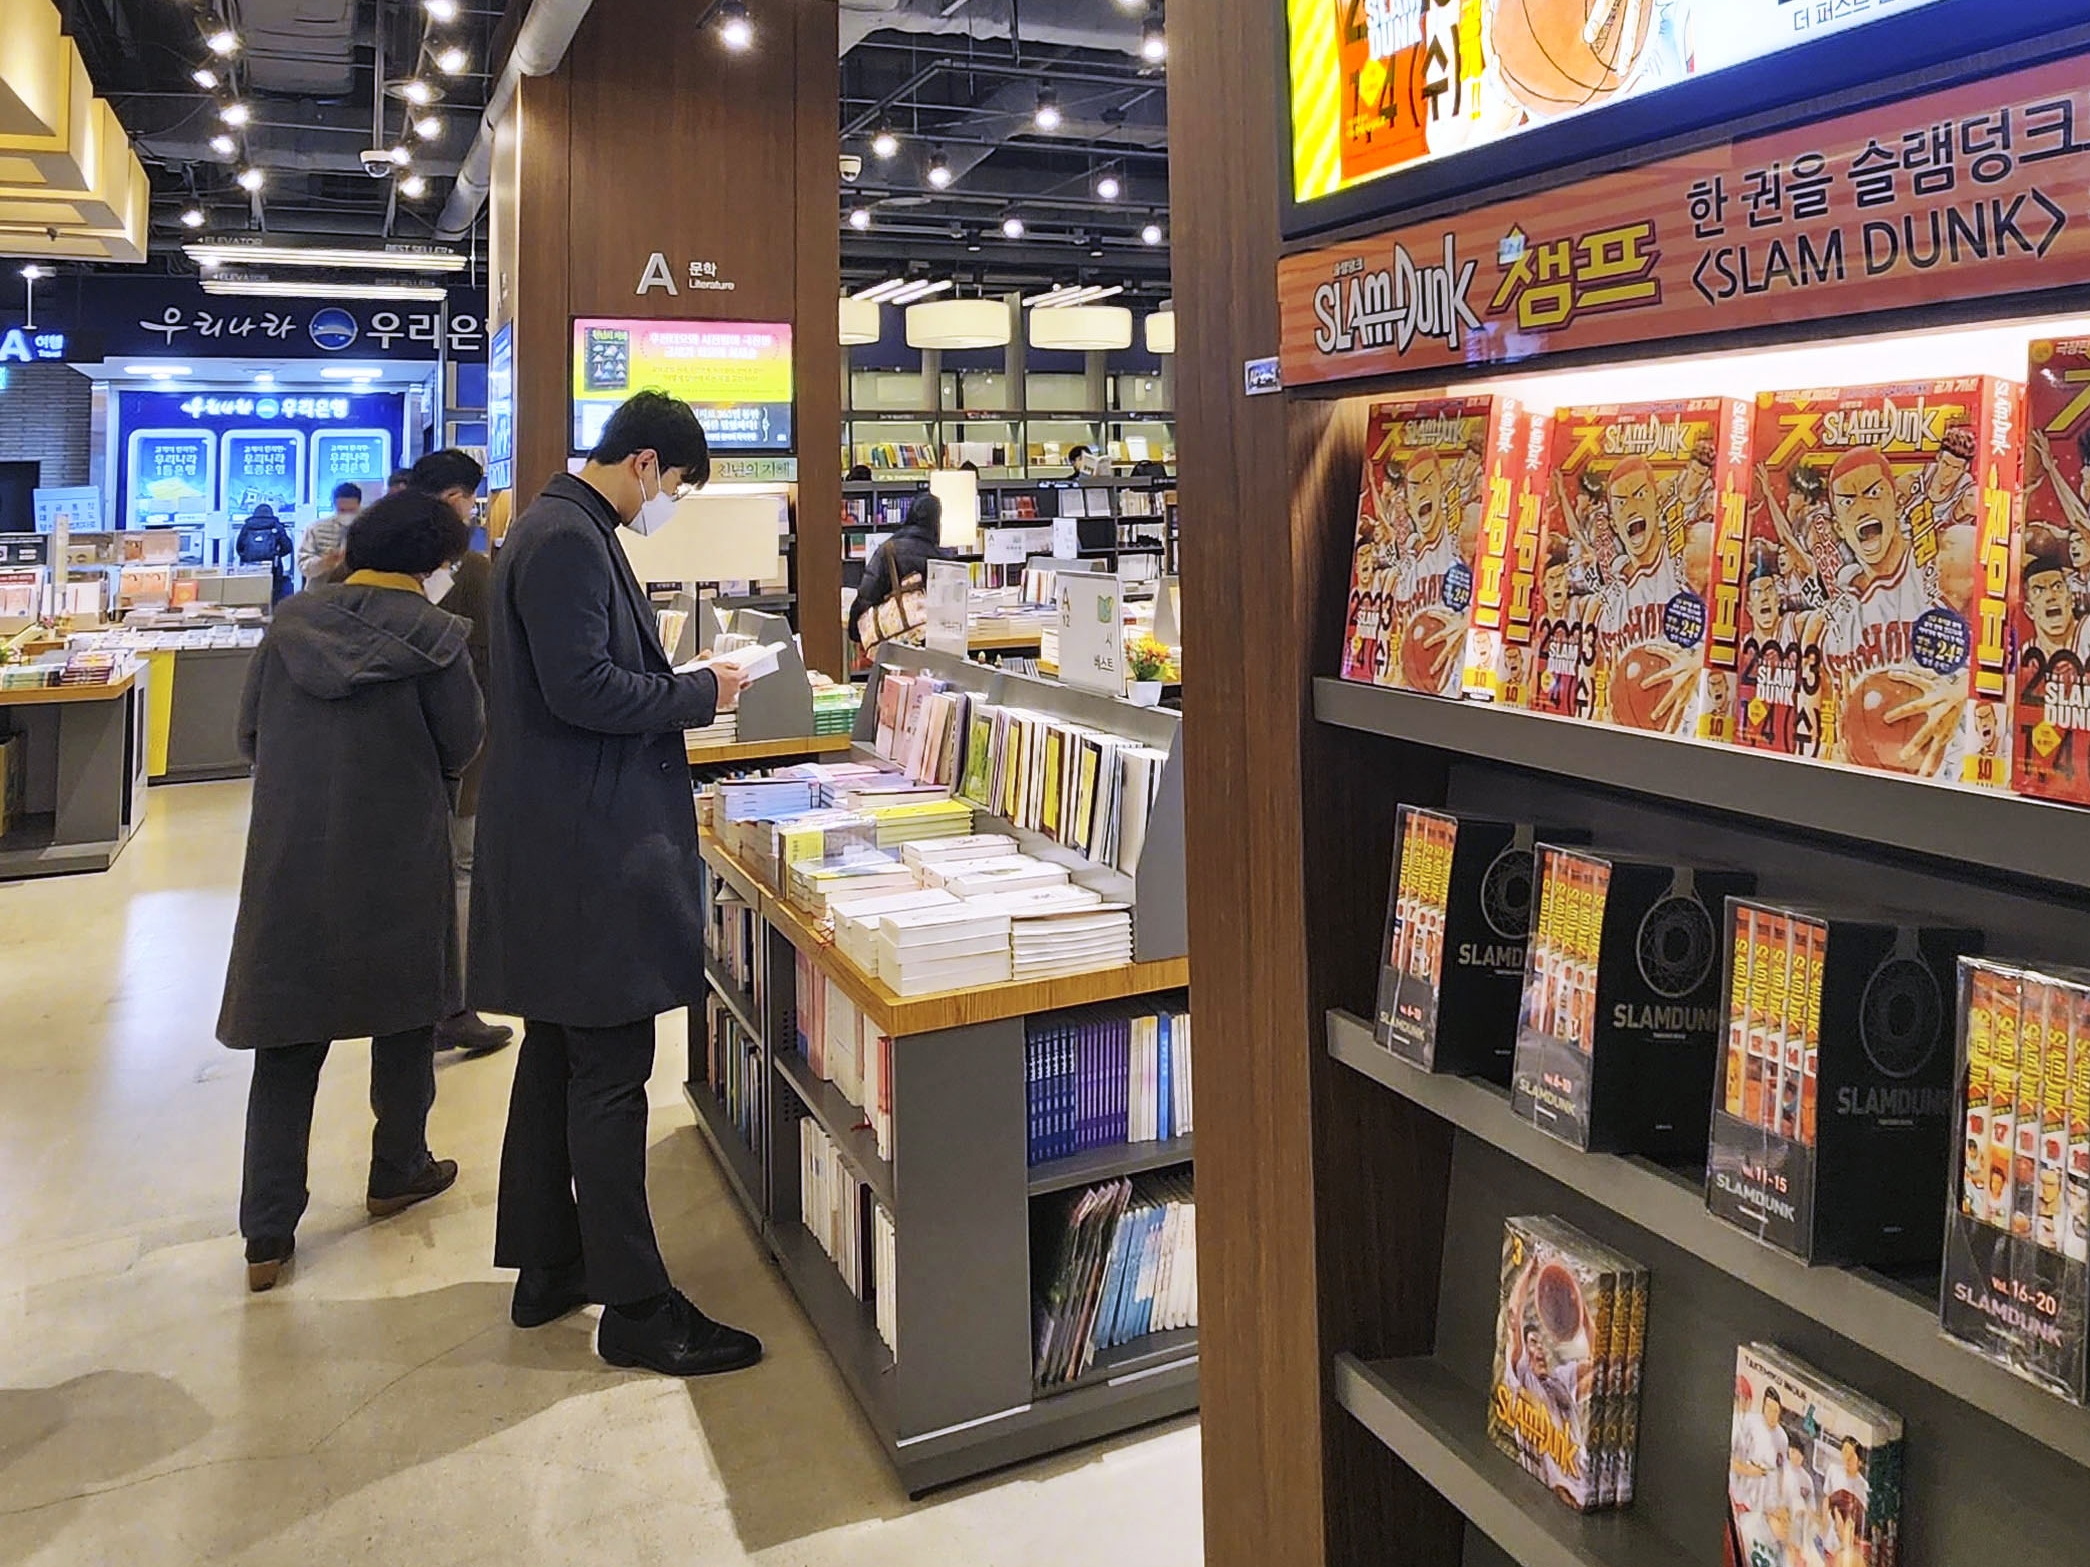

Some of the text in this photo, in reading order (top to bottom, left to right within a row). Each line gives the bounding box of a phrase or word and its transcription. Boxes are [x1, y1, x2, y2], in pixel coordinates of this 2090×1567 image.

[1793, 7, 1810, 31] 더
[1686, 99, 2090, 239] 한 권을 슬램덩크
[204, 235, 263, 247] ELEVATOR
[635, 251, 680, 297] A
[688, 261, 718, 278] 문학
[1486, 219, 1662, 335] 챔프
[139, 306, 489, 351] 우리나라 우리은
[0, 328, 32, 362] A
[180, 395, 350, 419] 우리나라 우리은행
[1061, 585, 1071, 614] A
[1548, 640, 1579, 660] SLAM
[1757, 665, 1796, 688] SLAM
[1756, 684, 1795, 707] DUNK
[2043, 703, 2090, 732] DUN
[1458, 944, 1526, 967] SLAMD
[1518, 1076, 1578, 1116] SLAMDUNK
[1715, 1173, 1796, 1223] SLAMDUNK
[1511, 1237, 1523, 1266] 3
[2012, 1279, 2058, 1318] 16-20
[1954, 1281, 2064, 1347] SLAMDUNK
